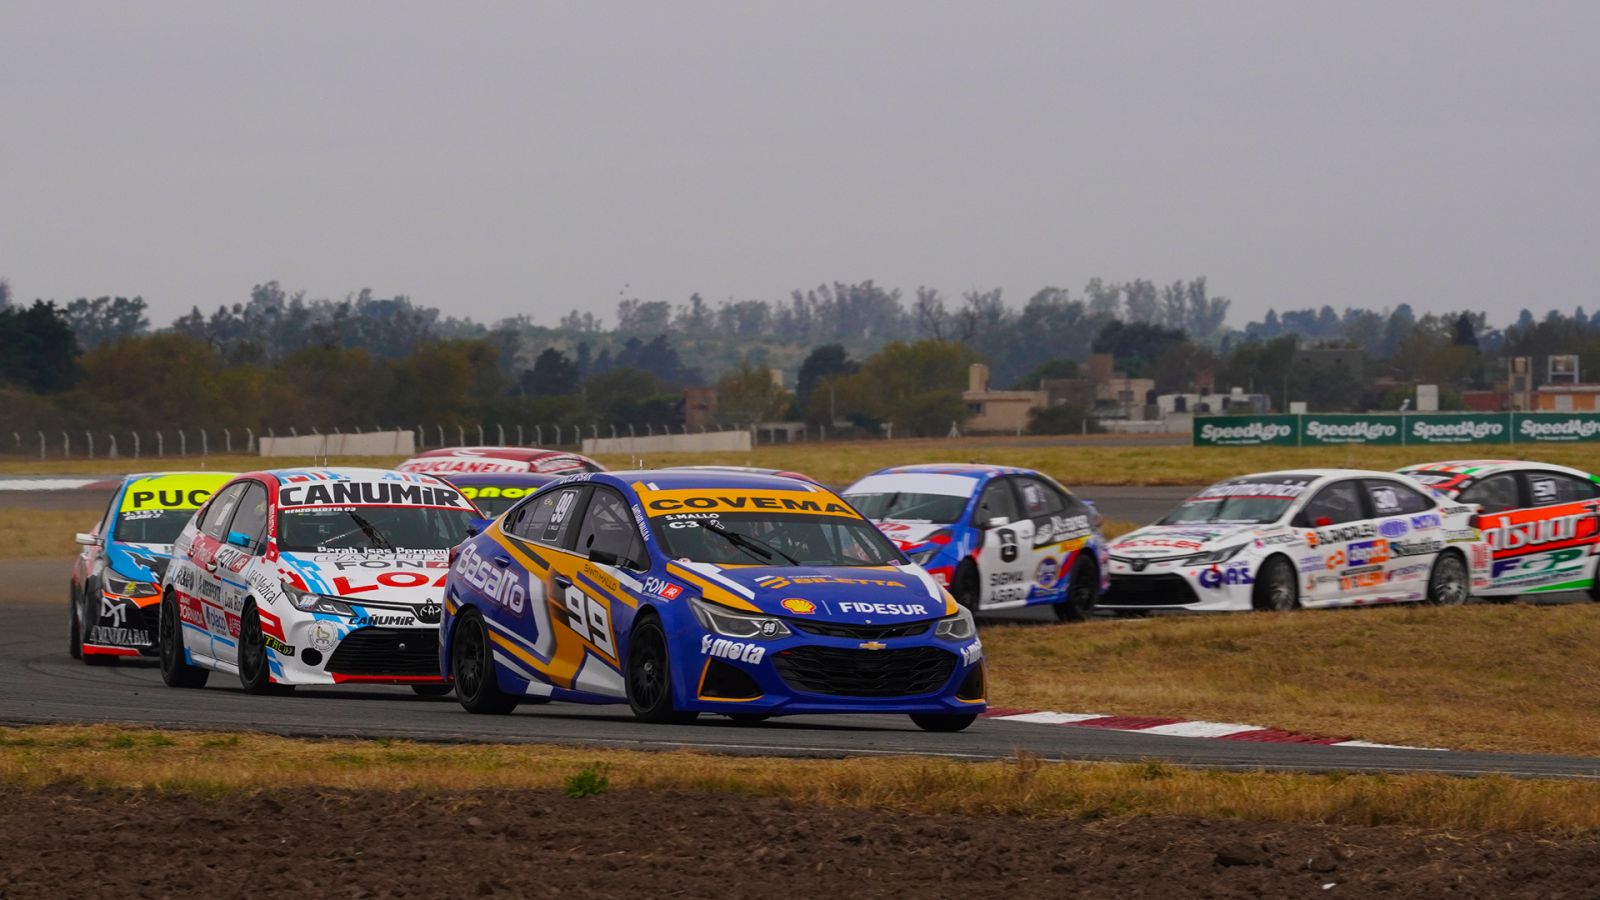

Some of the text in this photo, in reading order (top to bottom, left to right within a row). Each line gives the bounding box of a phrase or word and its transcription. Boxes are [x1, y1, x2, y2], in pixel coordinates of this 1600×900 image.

[1200, 422, 1291, 441] SpeedAgro
[1306, 420, 1396, 439] SpeedAgro
[1412, 420, 1503, 438] SpeedAgro
[1520, 419, 1600, 437] SpeedAgr
[551, 493, 574, 523] 99
[649, 497, 858, 515] COVEMA
[669, 521, 700, 529] C3
[839, 602, 928, 615] FIDESUR
[565, 585, 616, 658] 99
[763, 623, 775, 633] 99
